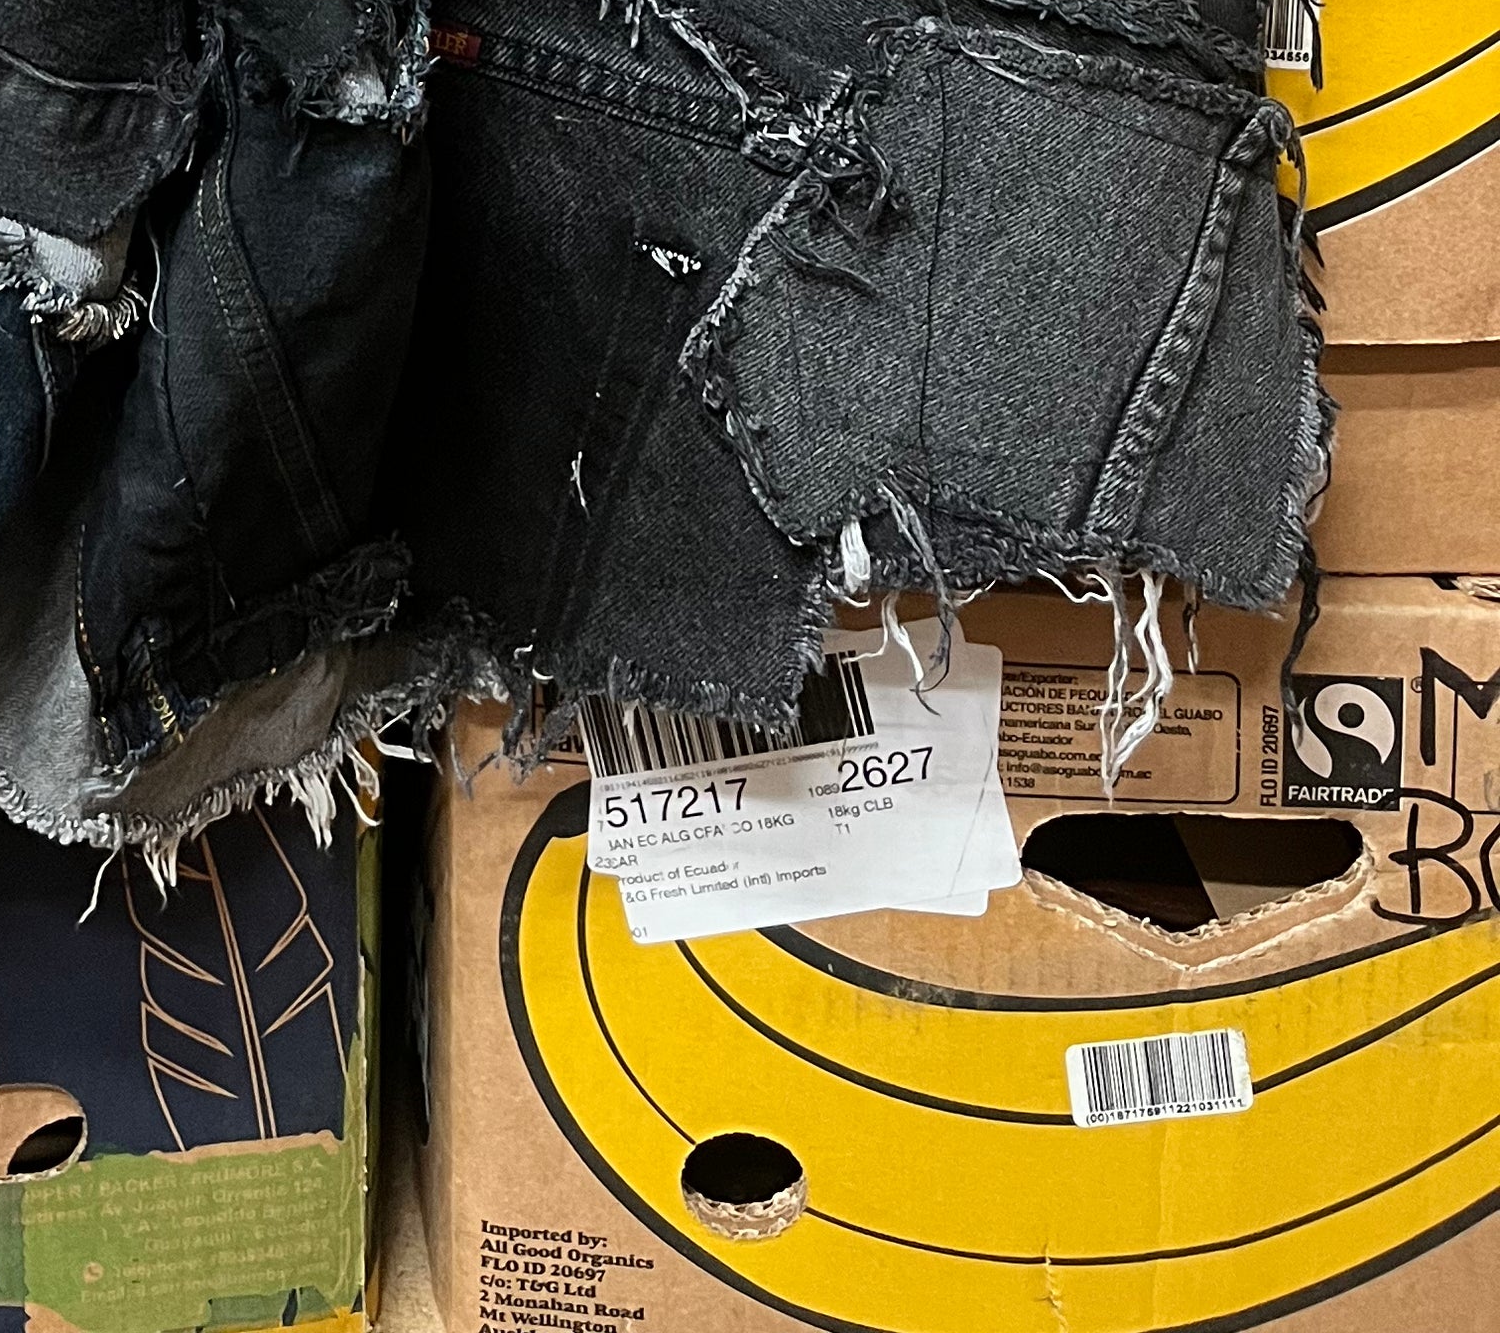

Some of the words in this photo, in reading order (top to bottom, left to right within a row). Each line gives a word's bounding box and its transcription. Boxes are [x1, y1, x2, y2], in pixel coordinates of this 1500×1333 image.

[1048, 686, 1066, 700] DE
[1262, 705, 1279, 756] 20697
[1261, 760, 1277, 776] ID
[604, 777, 748, 829] 517217
[838, 746, 934, 794] 2627
[1261, 779, 1277, 807] FLO
[828, 803, 860, 819] 18kg
[864, 797, 894, 813] CLB
[637, 834, 659, 848] EC
[661, 829, 690, 845] ALG
[757, 813, 795, 831] 18KG
[650, 884, 687, 900] Fresh
[776, 864, 827, 883] Imports
[667, 866, 681, 879] of
[481, 1219, 572, 1244] Imported
[577, 1231, 608, 1250] by:
[480, 1238, 508, 1254] All
[512, 1243, 562, 1260] Good
[567, 1249, 654, 1270] Organics
[481, 1255, 519, 1272] FLO
[523, 1261, 546, 1276] ID
[550, 1264, 606, 1283] 20697
[480, 1274, 512, 1289] c/o:
[516, 1277, 559, 1294] T&G
[564, 1283, 596, 1299] Ltd
[479, 1289, 490, 1302] 2
[494, 1292, 589, 1315] Monahan
[594, 1303, 645, 1321] Road
[479, 1306, 506, 1323] Mt
[511, 1312, 617, 1333] Wellington
